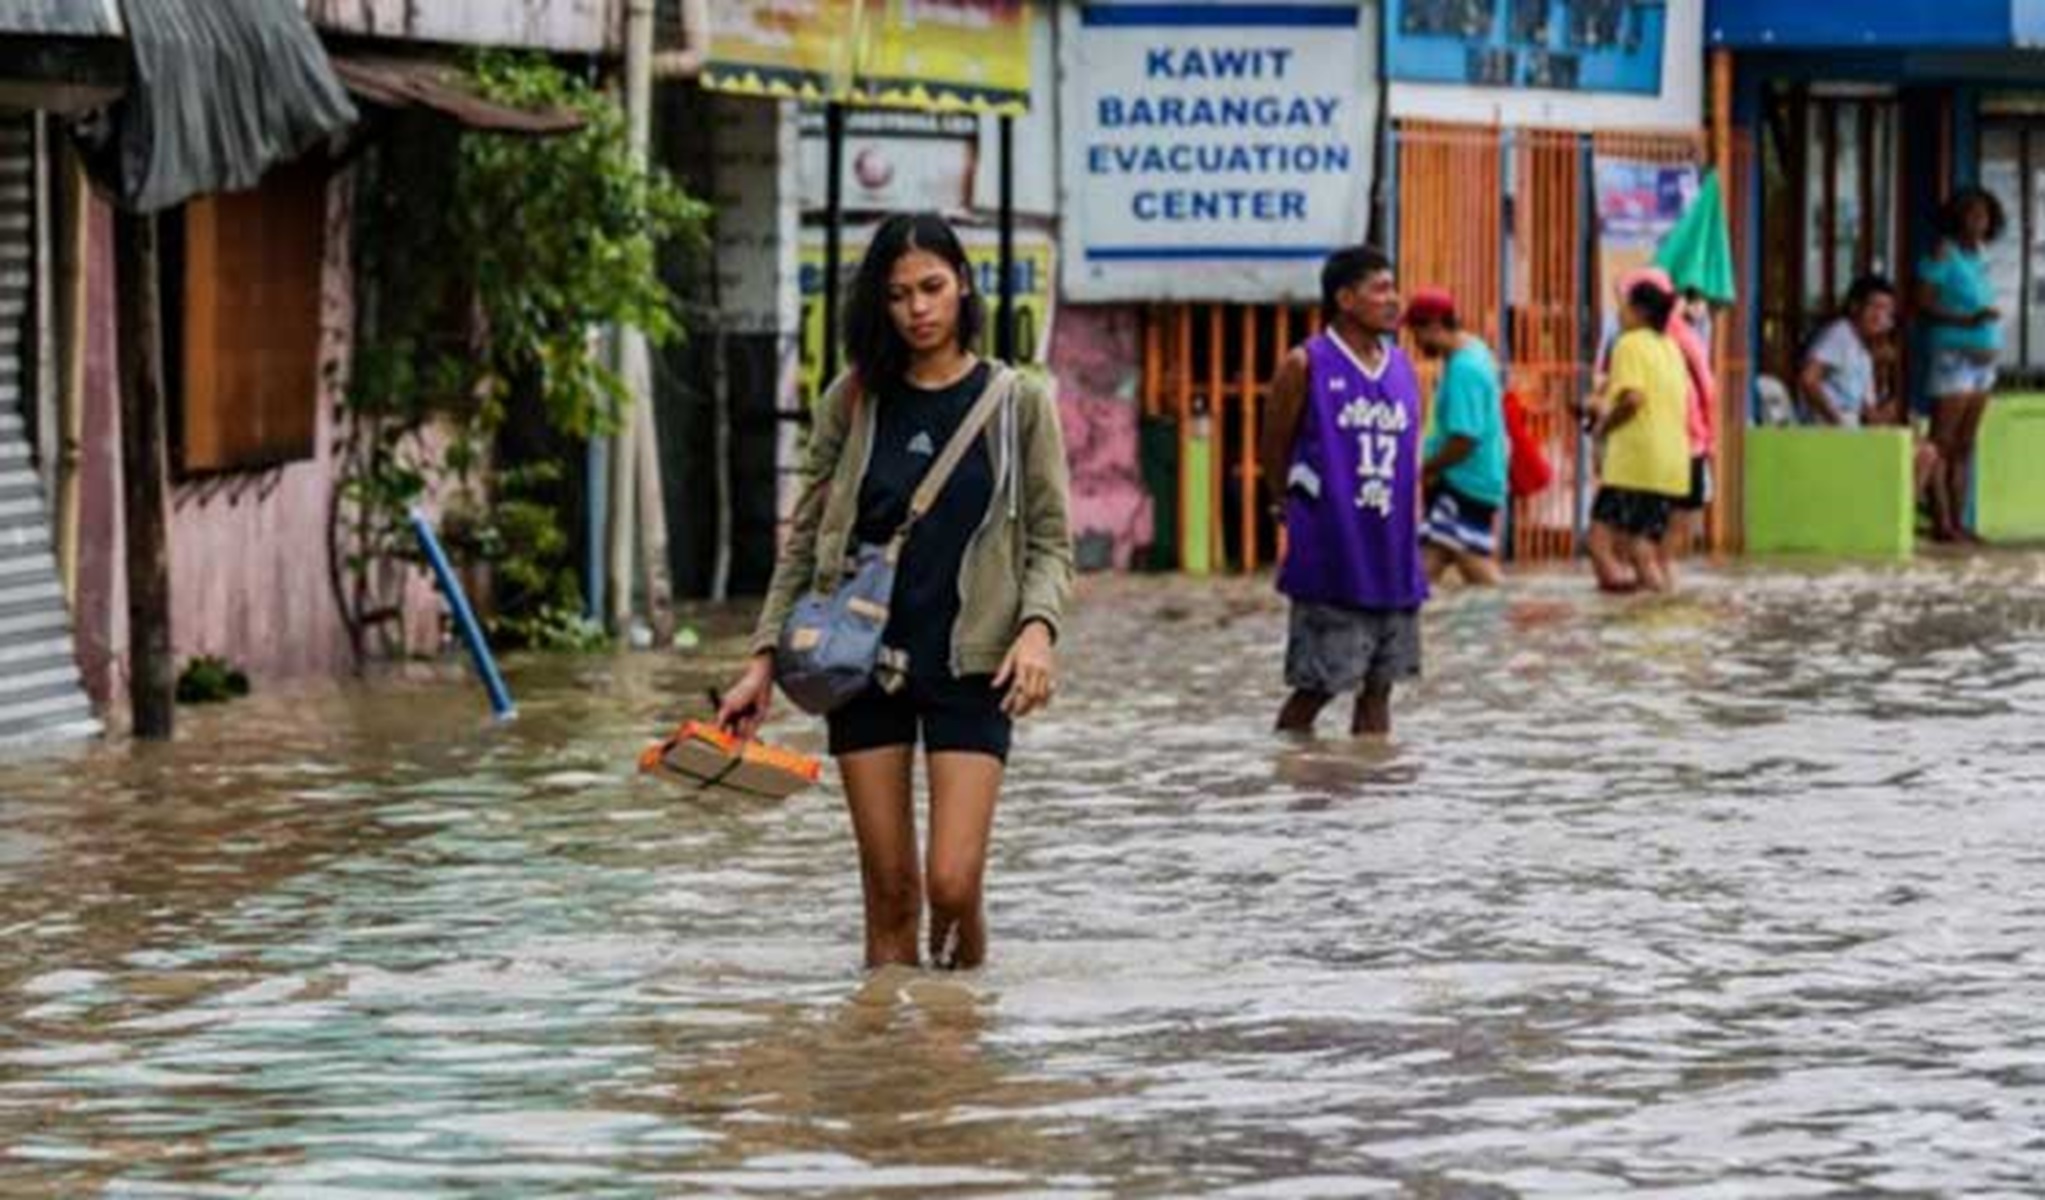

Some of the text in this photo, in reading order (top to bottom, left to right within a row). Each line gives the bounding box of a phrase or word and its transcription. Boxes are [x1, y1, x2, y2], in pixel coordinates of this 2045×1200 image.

[1146, 47, 1293, 78] KAWIT
[1097, 96, 1340, 127] BARANGAY
[1087, 144, 1349, 173] EVACUATION
[1131, 190, 1307, 220] CENTER
[1356, 432, 1397, 478] 17
